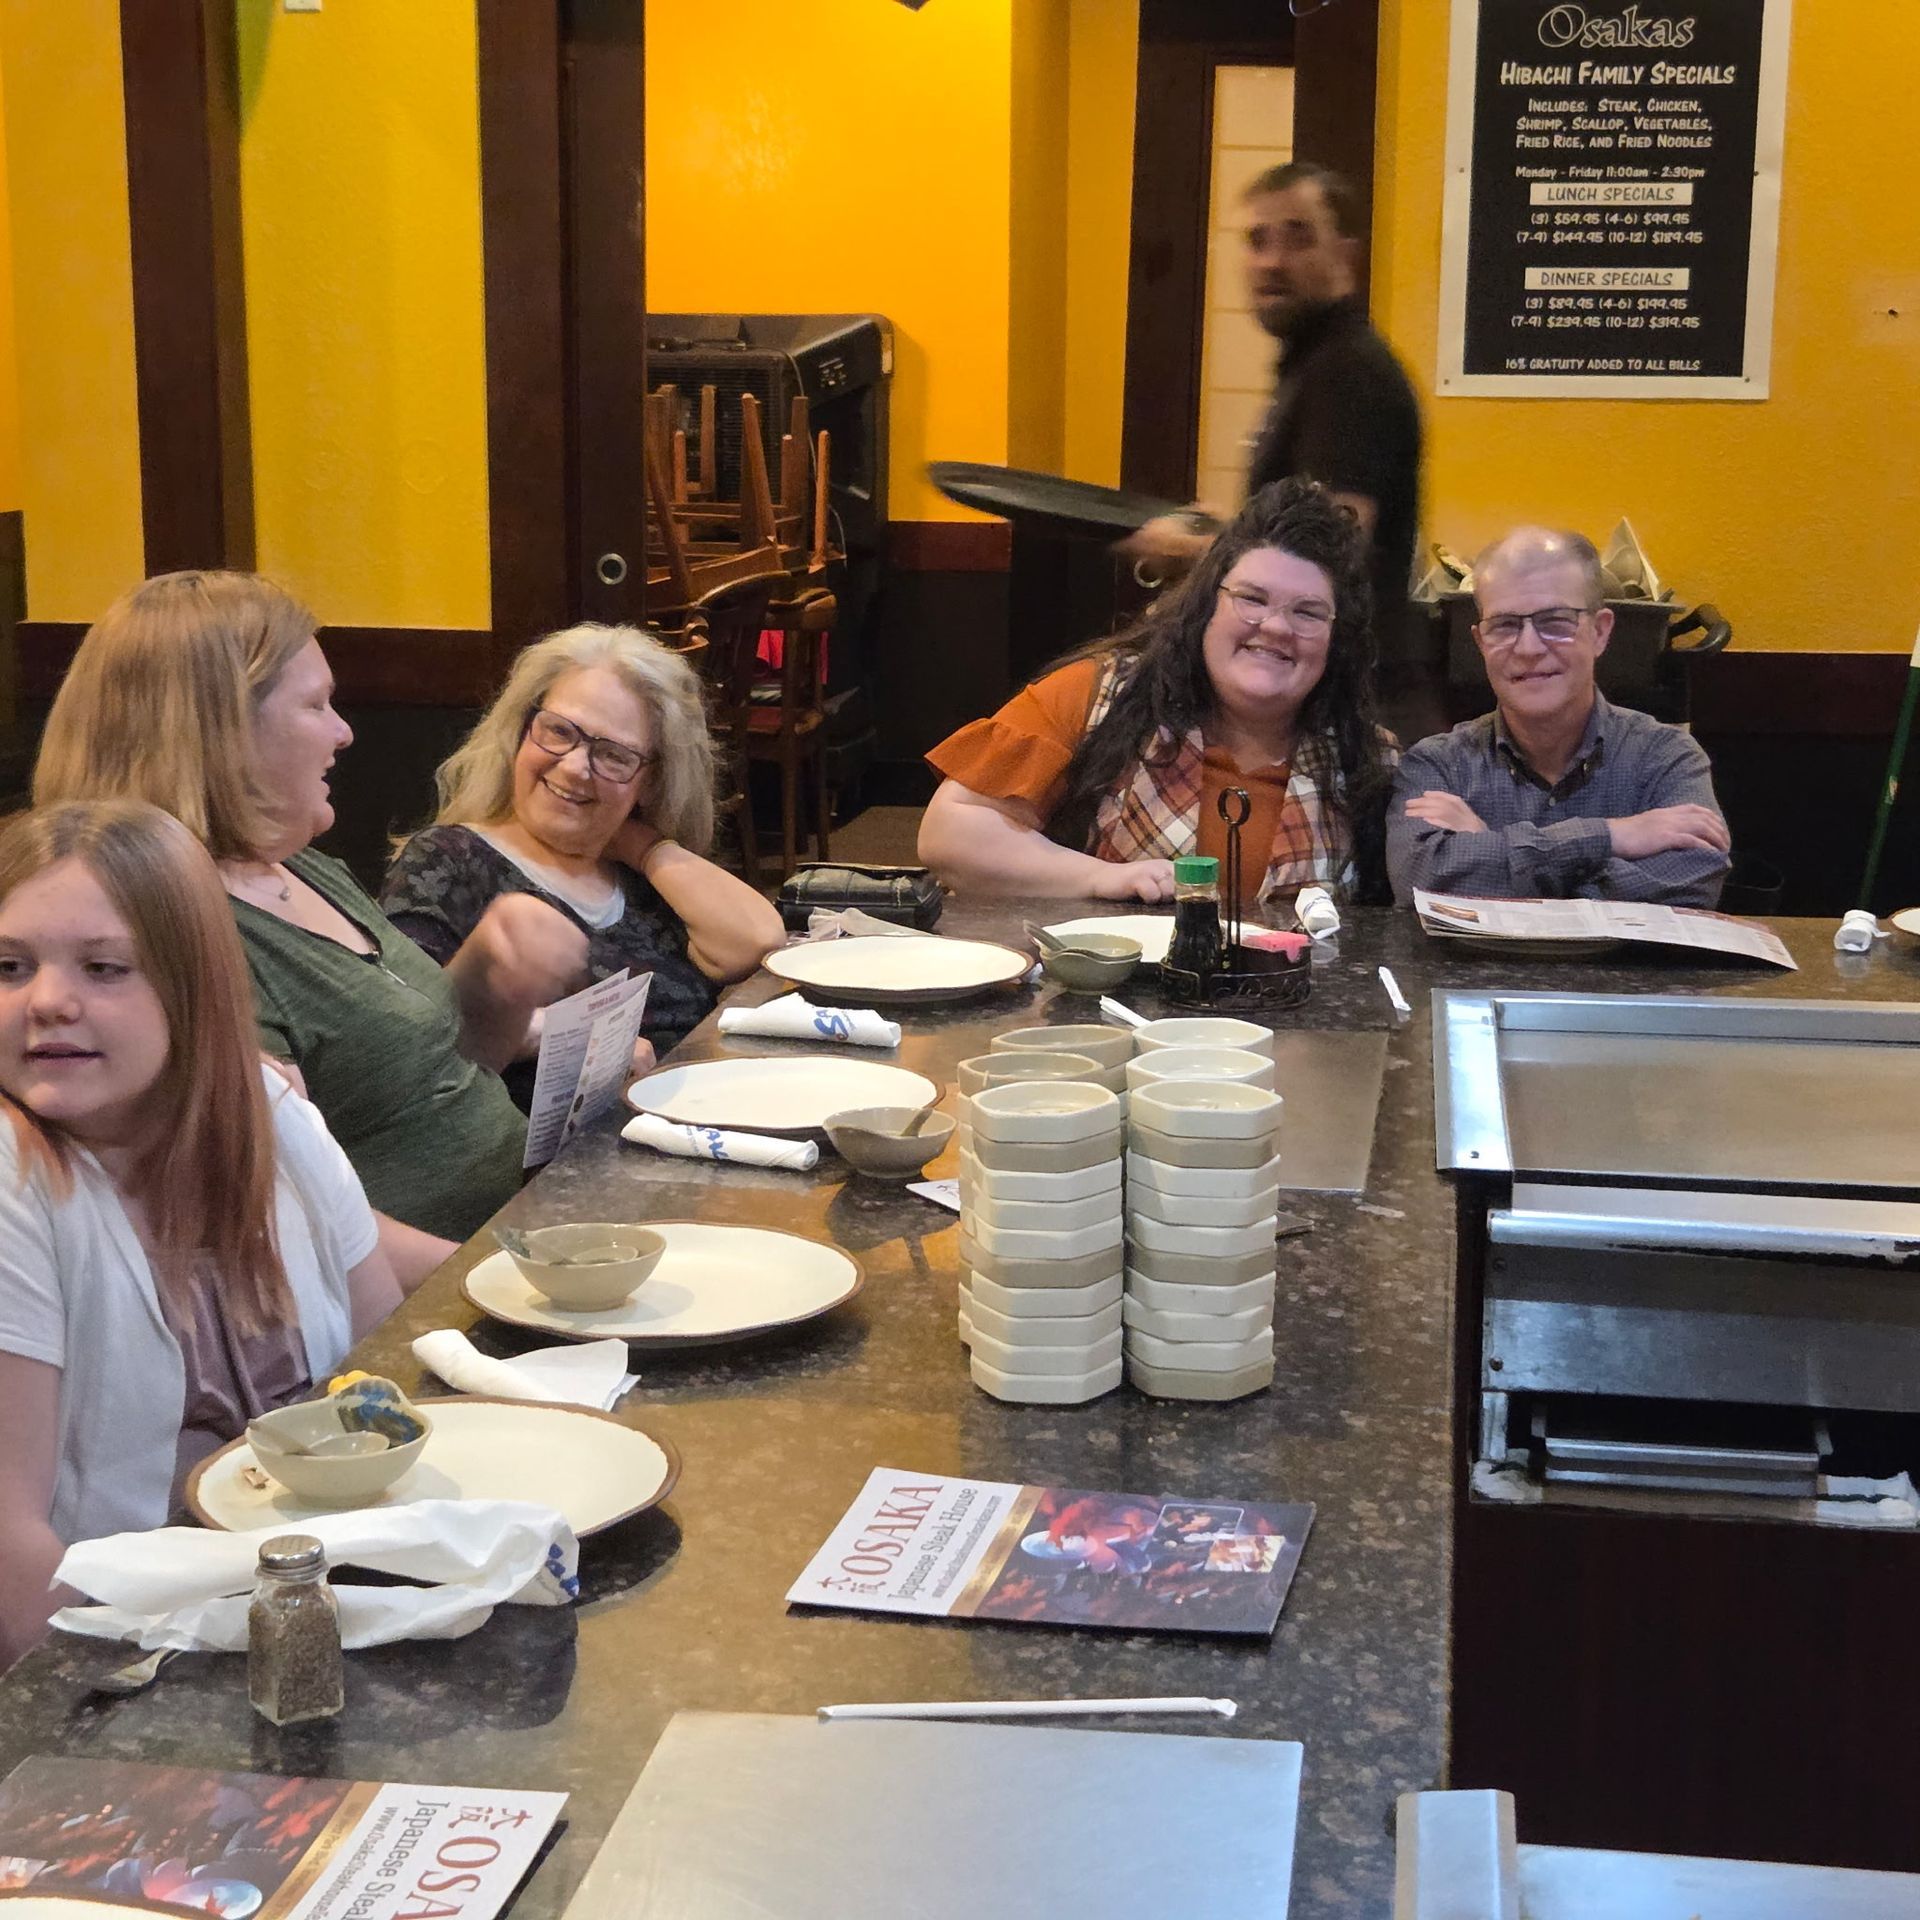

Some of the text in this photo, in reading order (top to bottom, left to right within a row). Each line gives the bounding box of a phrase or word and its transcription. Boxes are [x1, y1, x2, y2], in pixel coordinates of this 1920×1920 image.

[1538, 4, 1696, 48] Osakas
[1500, 60, 1736, 85] HIBACHI FAMILY SPECIALS
[1516, 134, 1549, 148] FRIED
[1589, 136, 1613, 148] AND
[1618, 134, 1652, 148] FRIED
[1657, 133, 1713, 148] NOODLES
[1515, 166, 1557, 180] Monday
[1569, 166, 1603, 180] Friday
[1547, 187, 1675, 201] LUNCH SPECIALS
[1516, 231, 1548, 244] (7-9)
[1608, 231, 1647, 244] (10-12)
[1541, 272, 1674, 286] DINNER SPECIALS
[1605, 315, 1644, 329] (10-12)
[1529, 358, 1585, 371] GRATUITY
[1587, 358, 1623, 371] ADDED
[1627, 358, 1641, 370] TO
[1645, 358, 1666, 370] ALL
[840, 1483, 944, 1577] OSAKA
[887, 1553, 938, 1601] Japanese
[920, 1524, 956, 1553] Steak
[938, 1486, 979, 1523] House
[376, 1799, 450, 1879] Japanese
[389, 1836, 501, 1920] OSA
